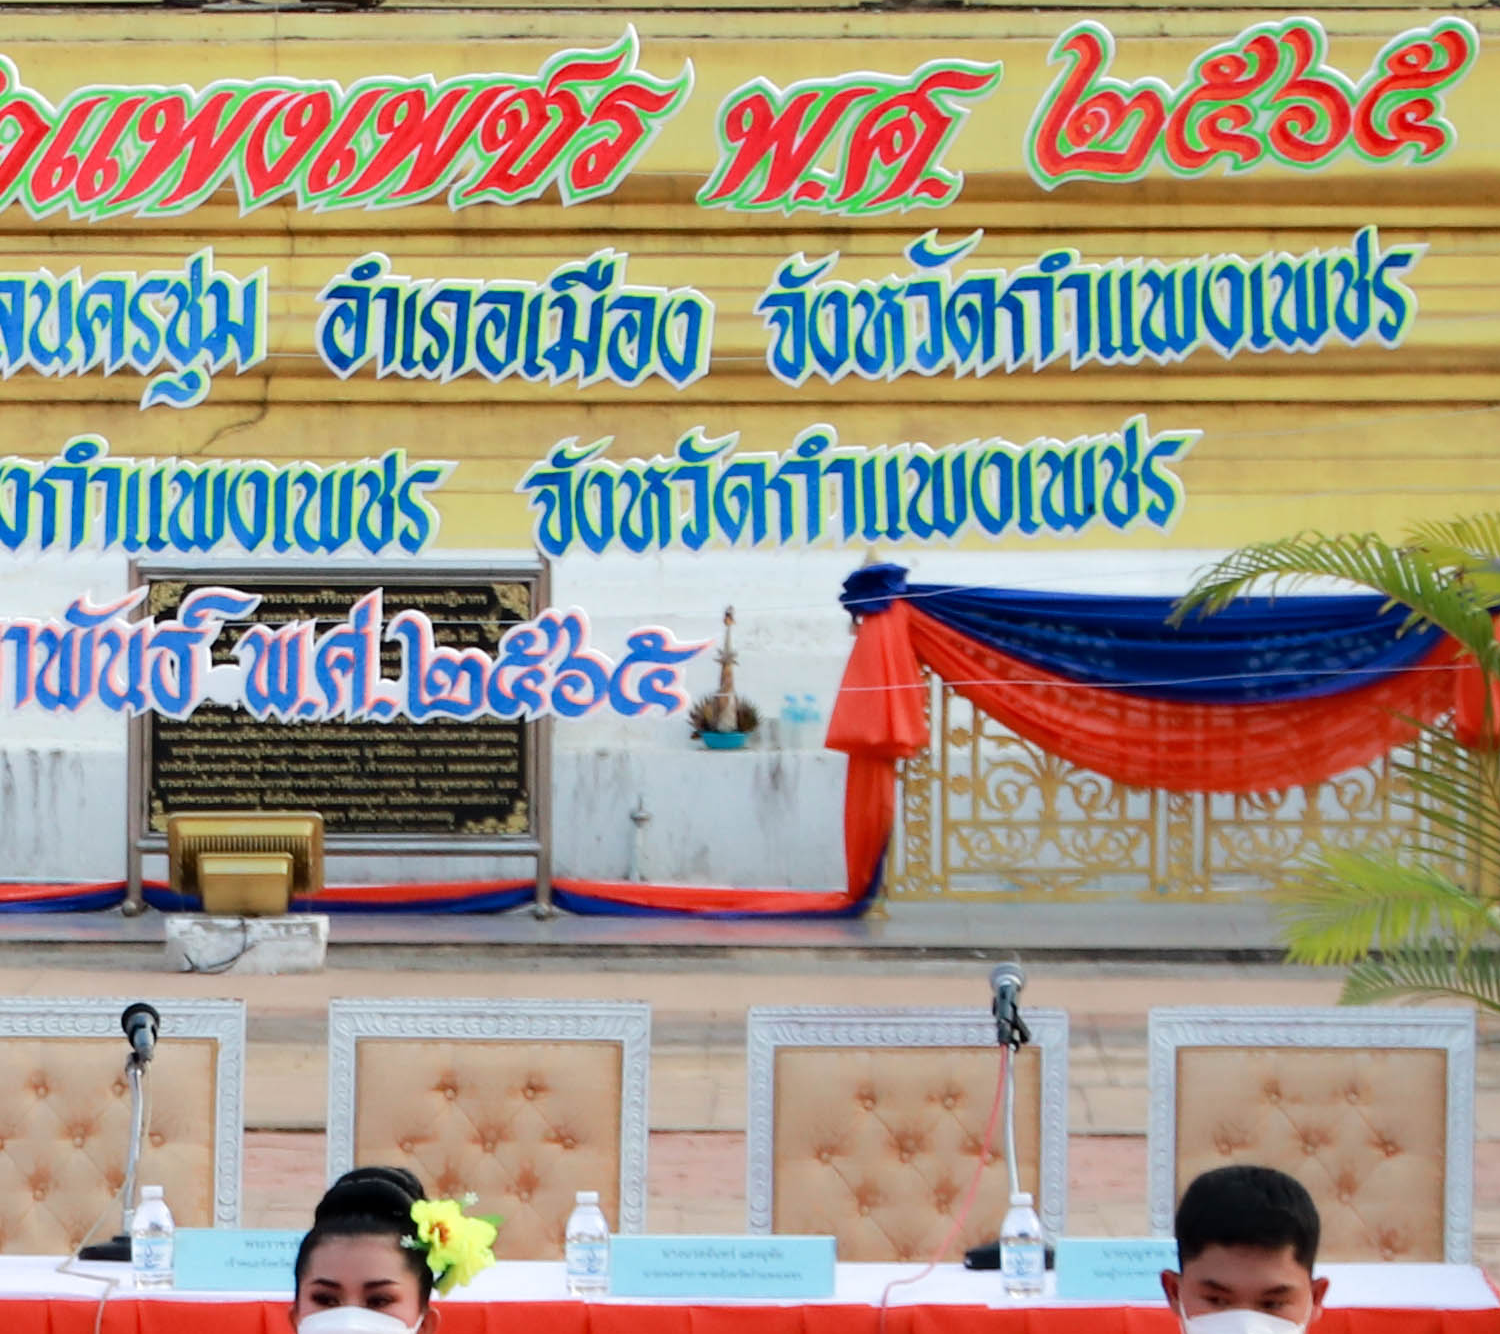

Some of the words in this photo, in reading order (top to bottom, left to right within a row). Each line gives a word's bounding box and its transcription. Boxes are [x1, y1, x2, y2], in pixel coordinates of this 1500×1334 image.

[702, 67, 998, 209] พ.ศ.
[1030, 21, 1475, 179] ๒๕๖๕
[318, 251, 709, 384] อำเภอเมือง
[760, 227, 1423, 383] จังหวัดกำแพงเพชร
[528, 415, 1196, 552] จังหวัดกำแพงเพชร
